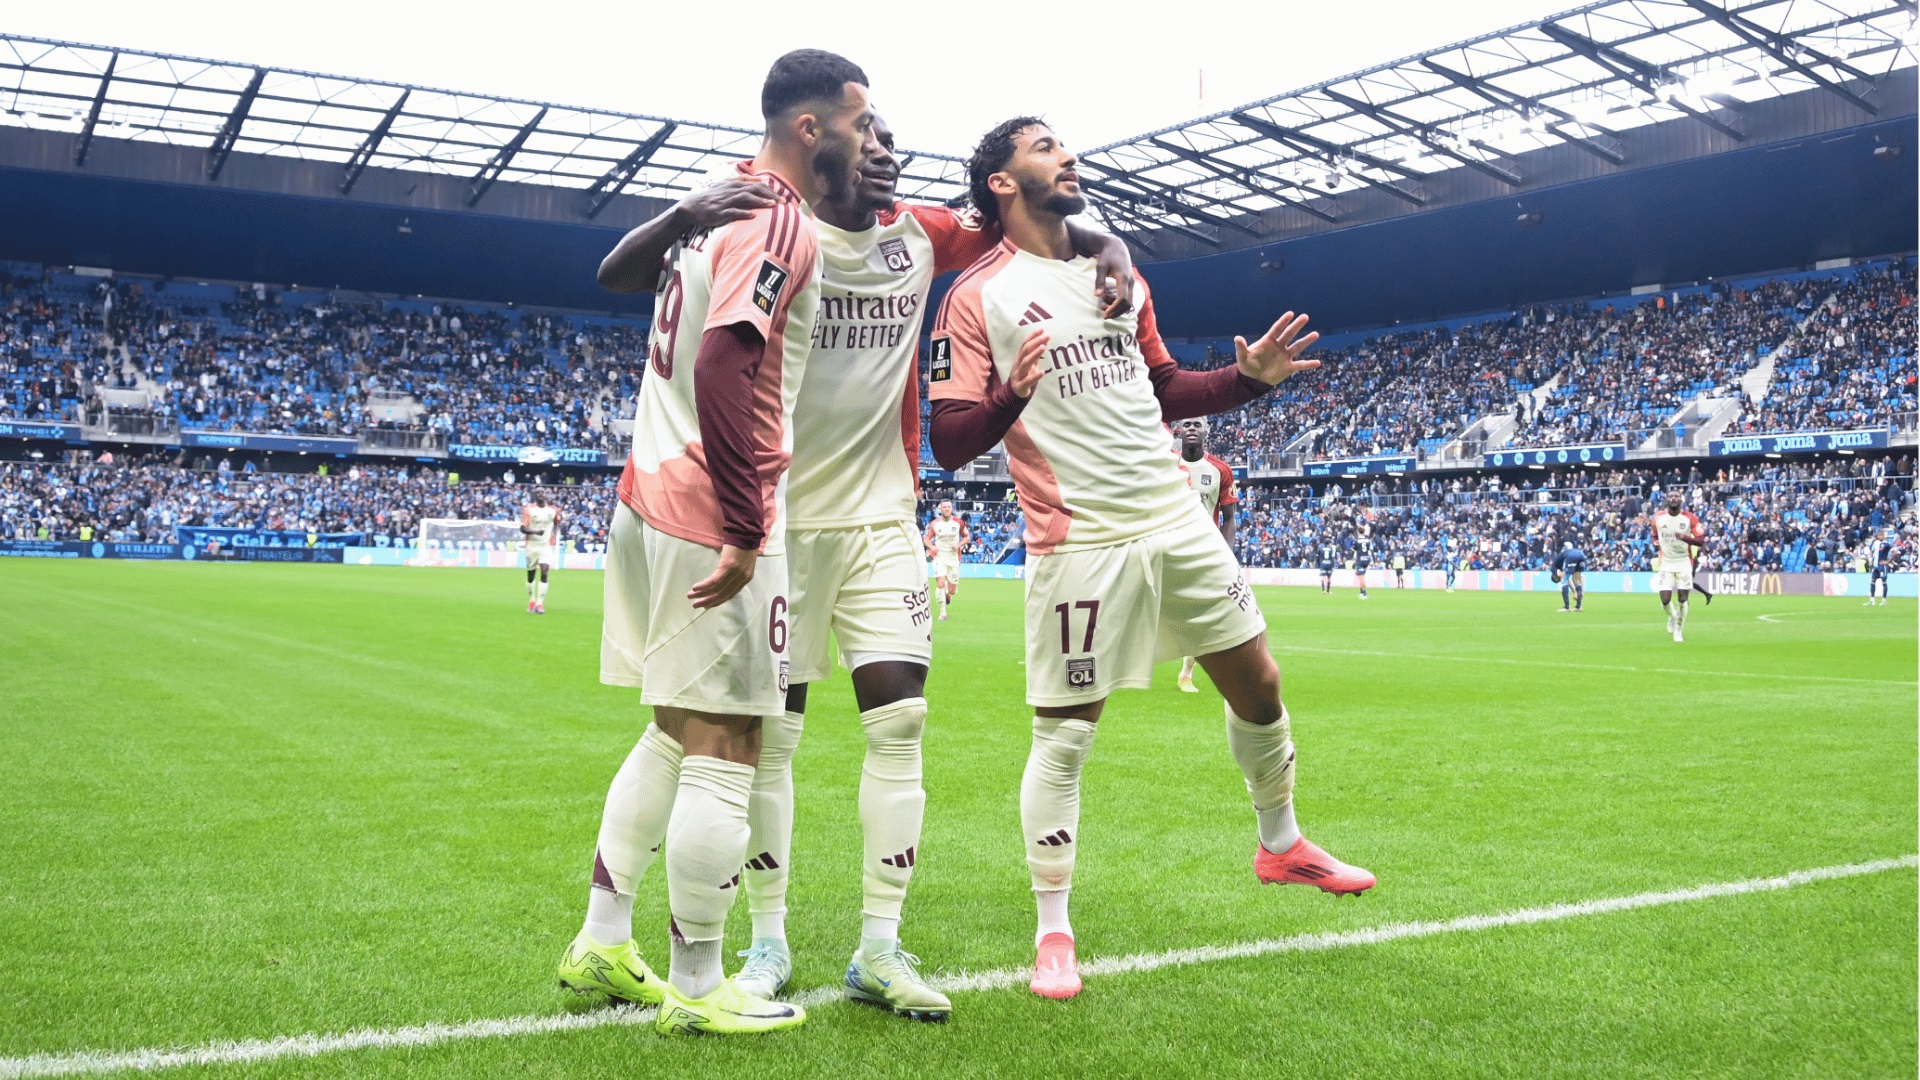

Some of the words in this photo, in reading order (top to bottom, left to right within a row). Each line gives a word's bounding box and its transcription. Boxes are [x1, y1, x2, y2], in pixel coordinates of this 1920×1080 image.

[820, 291, 918, 320] mirates
[846, 324, 904, 349] BETTER
[1058, 370, 1084, 399] FLY
[1091, 360, 1137, 389] BETTER
[1055, 600, 1100, 654] 17
